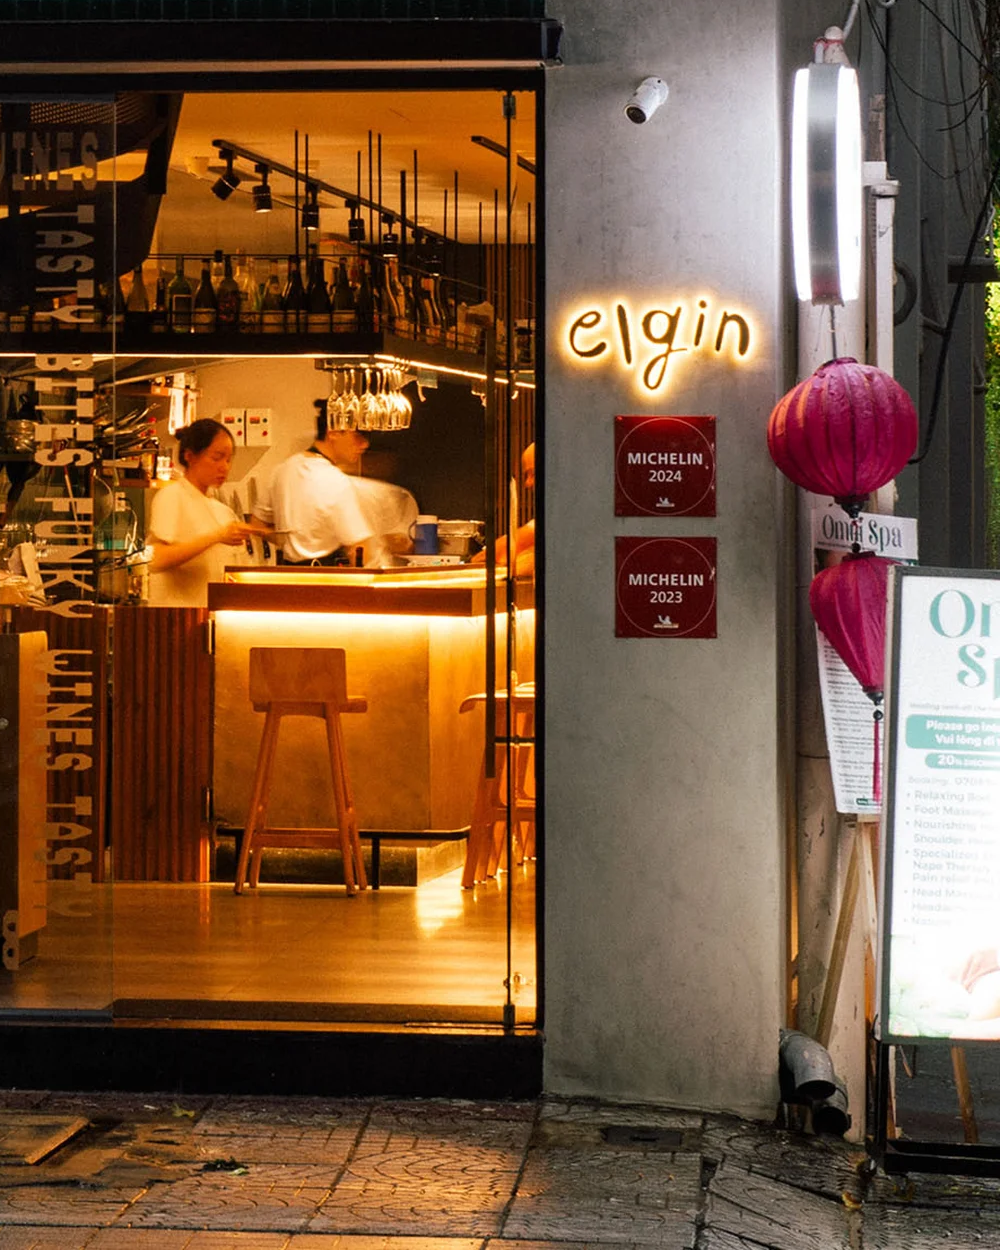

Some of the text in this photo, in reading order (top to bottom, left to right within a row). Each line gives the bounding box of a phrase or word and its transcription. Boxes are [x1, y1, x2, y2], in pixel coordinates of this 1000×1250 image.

[568, 299, 751, 391] elgin
[627, 452, 703, 466] MICHELIN
[648, 469, 683, 483] 2024
[867, 518, 903, 553] Spa
[33, 204, 95, 918] TASTY BITES FUNKY WINES TASTY
[628, 573, 704, 587] MICHELIN
[649, 590, 684, 604] 2023
[913, 804, 940, 815] Foot
